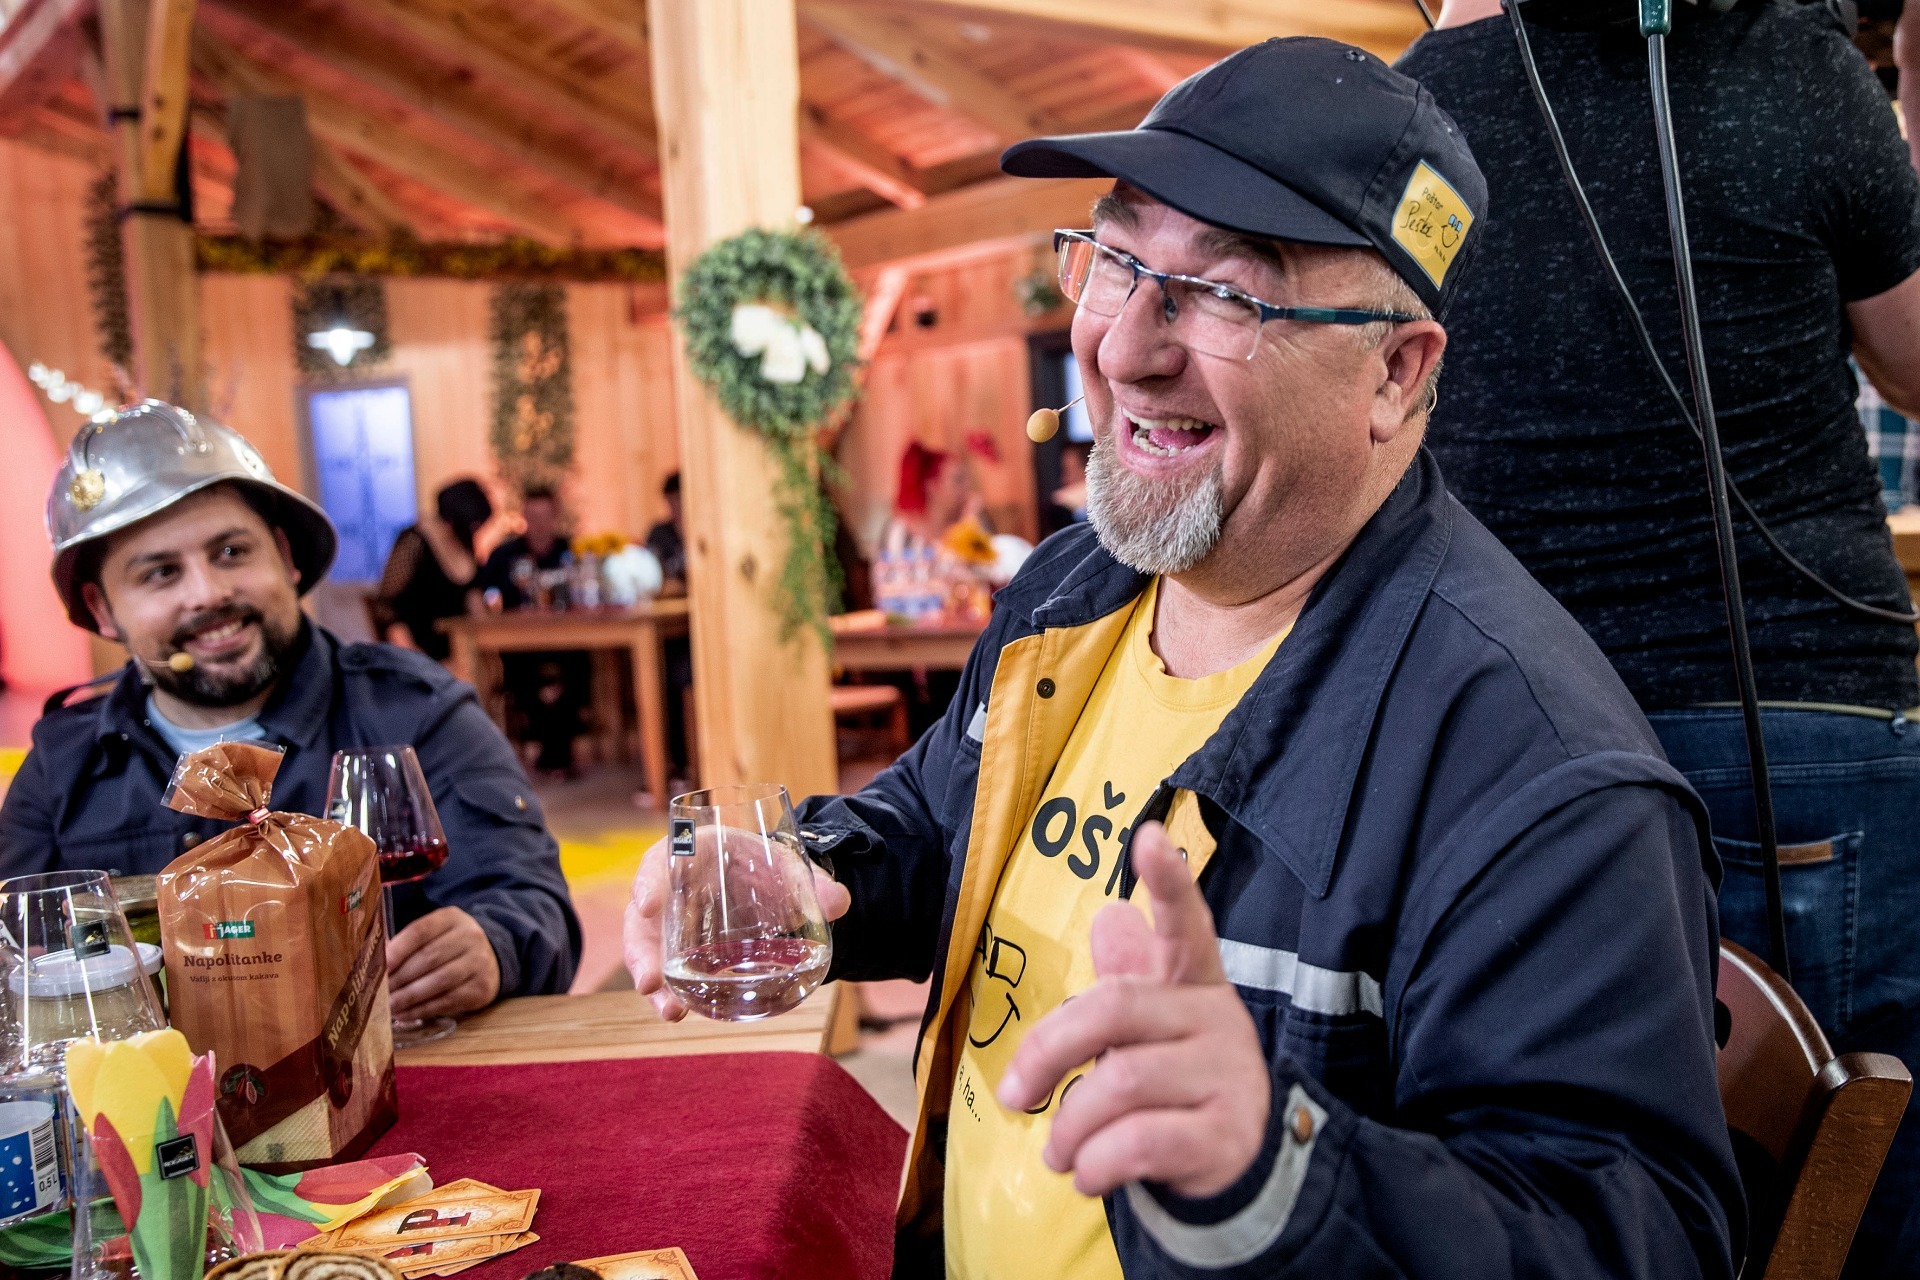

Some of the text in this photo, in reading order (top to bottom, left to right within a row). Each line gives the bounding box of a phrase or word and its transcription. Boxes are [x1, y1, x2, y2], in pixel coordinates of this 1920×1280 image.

[1421, 186, 1444, 210] Poštar
[183, 951, 283, 970] Napolitanke
[249, 973, 280, 981] kakava
[39, 1177, 52, 1192] 0,5
[53, 1173, 58, 1185] L
